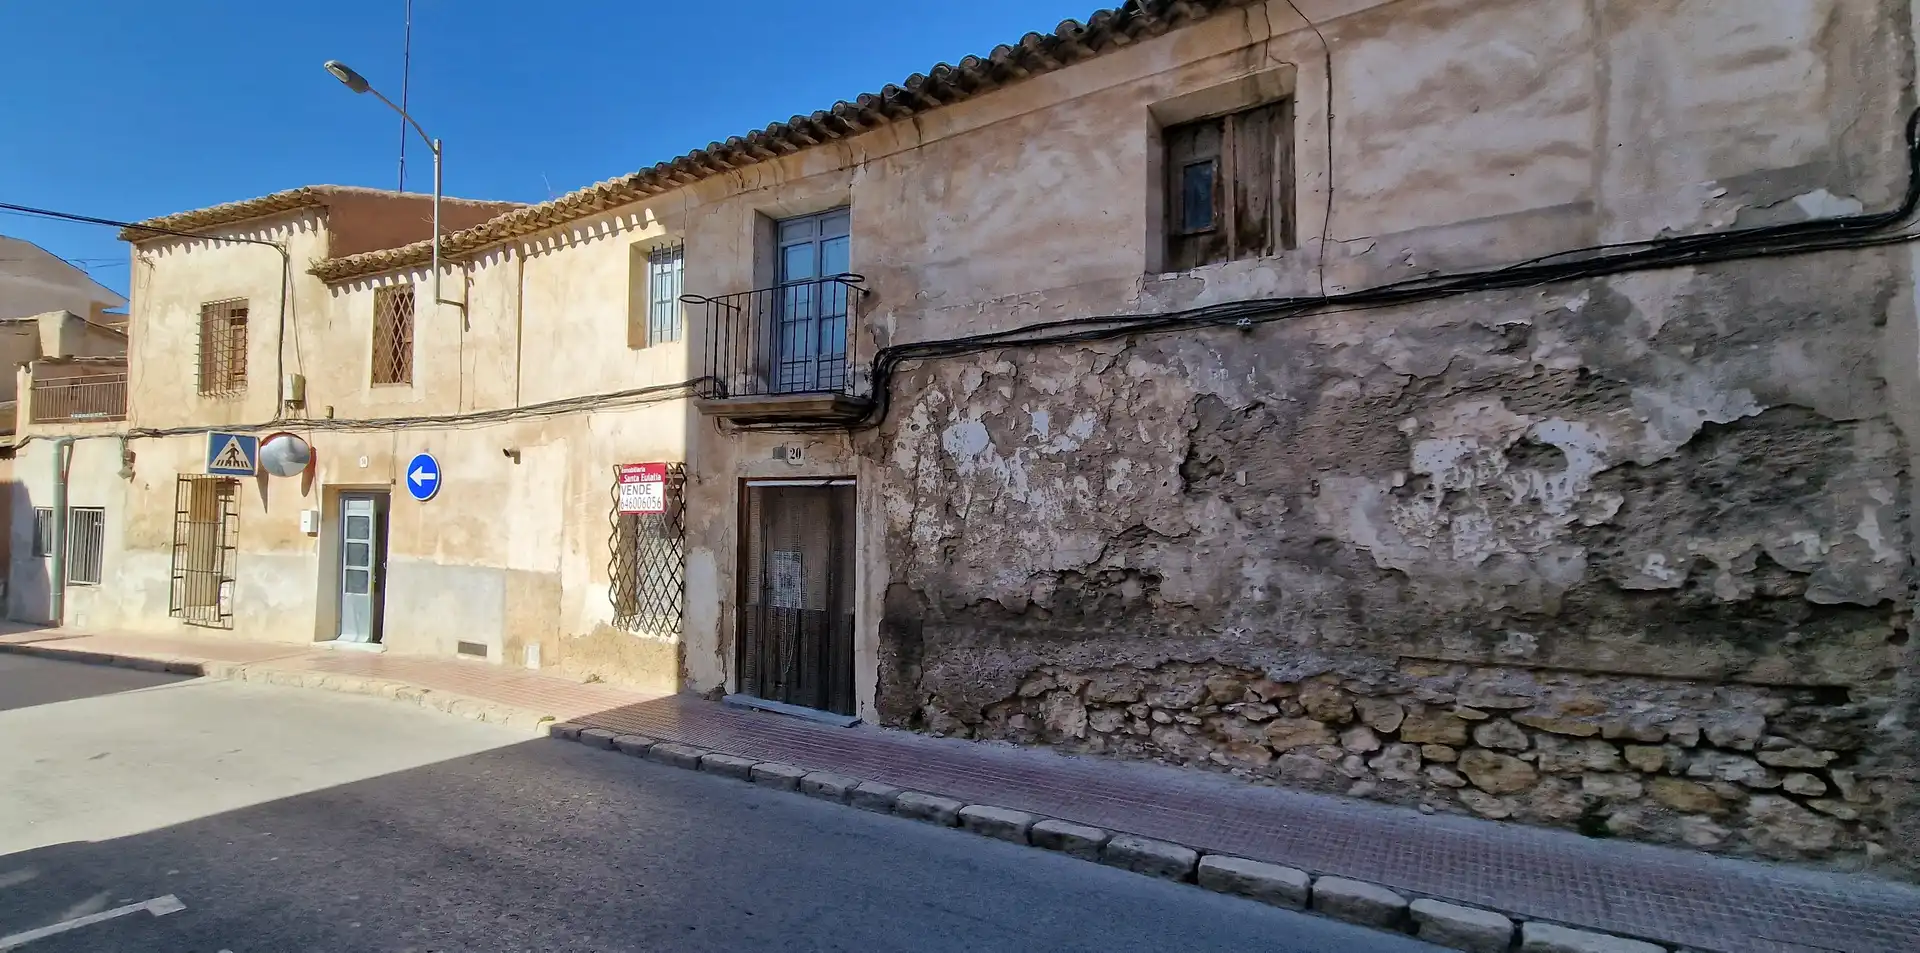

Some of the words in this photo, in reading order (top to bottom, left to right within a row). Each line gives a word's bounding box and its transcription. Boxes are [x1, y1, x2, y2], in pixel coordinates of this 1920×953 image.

[790, 448, 801, 459] 20
[641, 473, 661, 481] Eulalia
[621, 484, 651, 495] VENDE
[620, 497, 661, 509] 646006056
